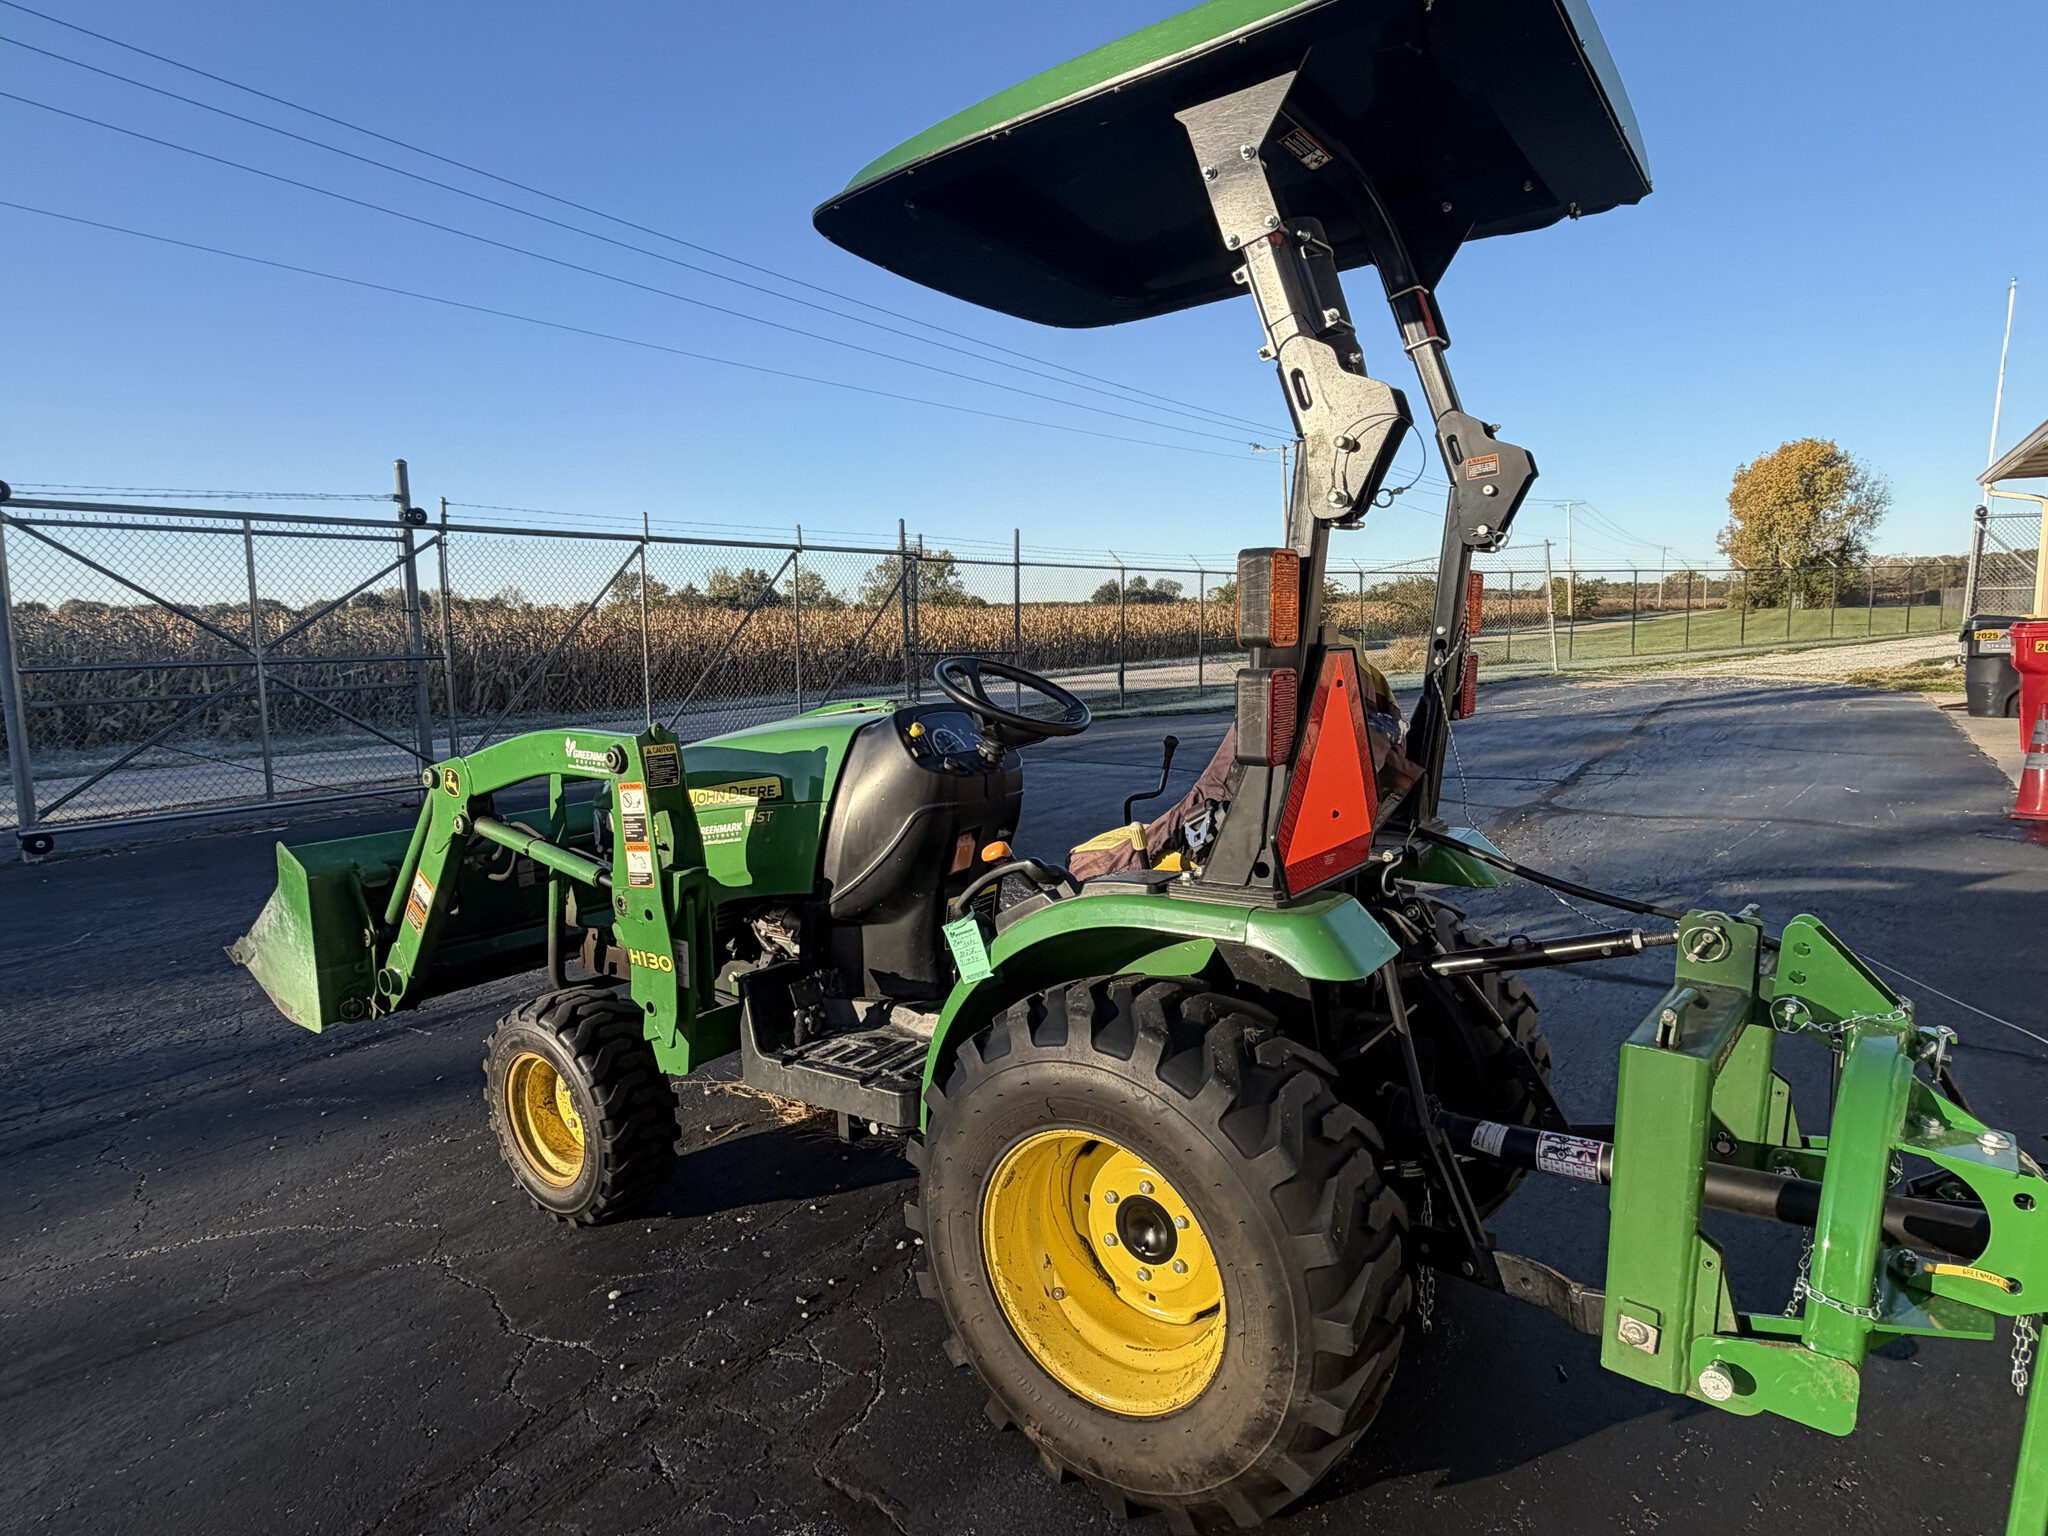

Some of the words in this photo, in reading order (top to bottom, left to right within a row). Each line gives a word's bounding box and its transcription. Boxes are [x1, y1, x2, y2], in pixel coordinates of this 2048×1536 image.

[573, 750, 607, 761] GREENMA
[693, 789, 725, 804] JOHN
[729, 785, 776, 799] DEERE
[746, 809, 774, 826] HST
[700, 822, 742, 835] REENMARK
[629, 948, 673, 973] H130
[1962, 1268, 2001, 1284] GREENMARK
